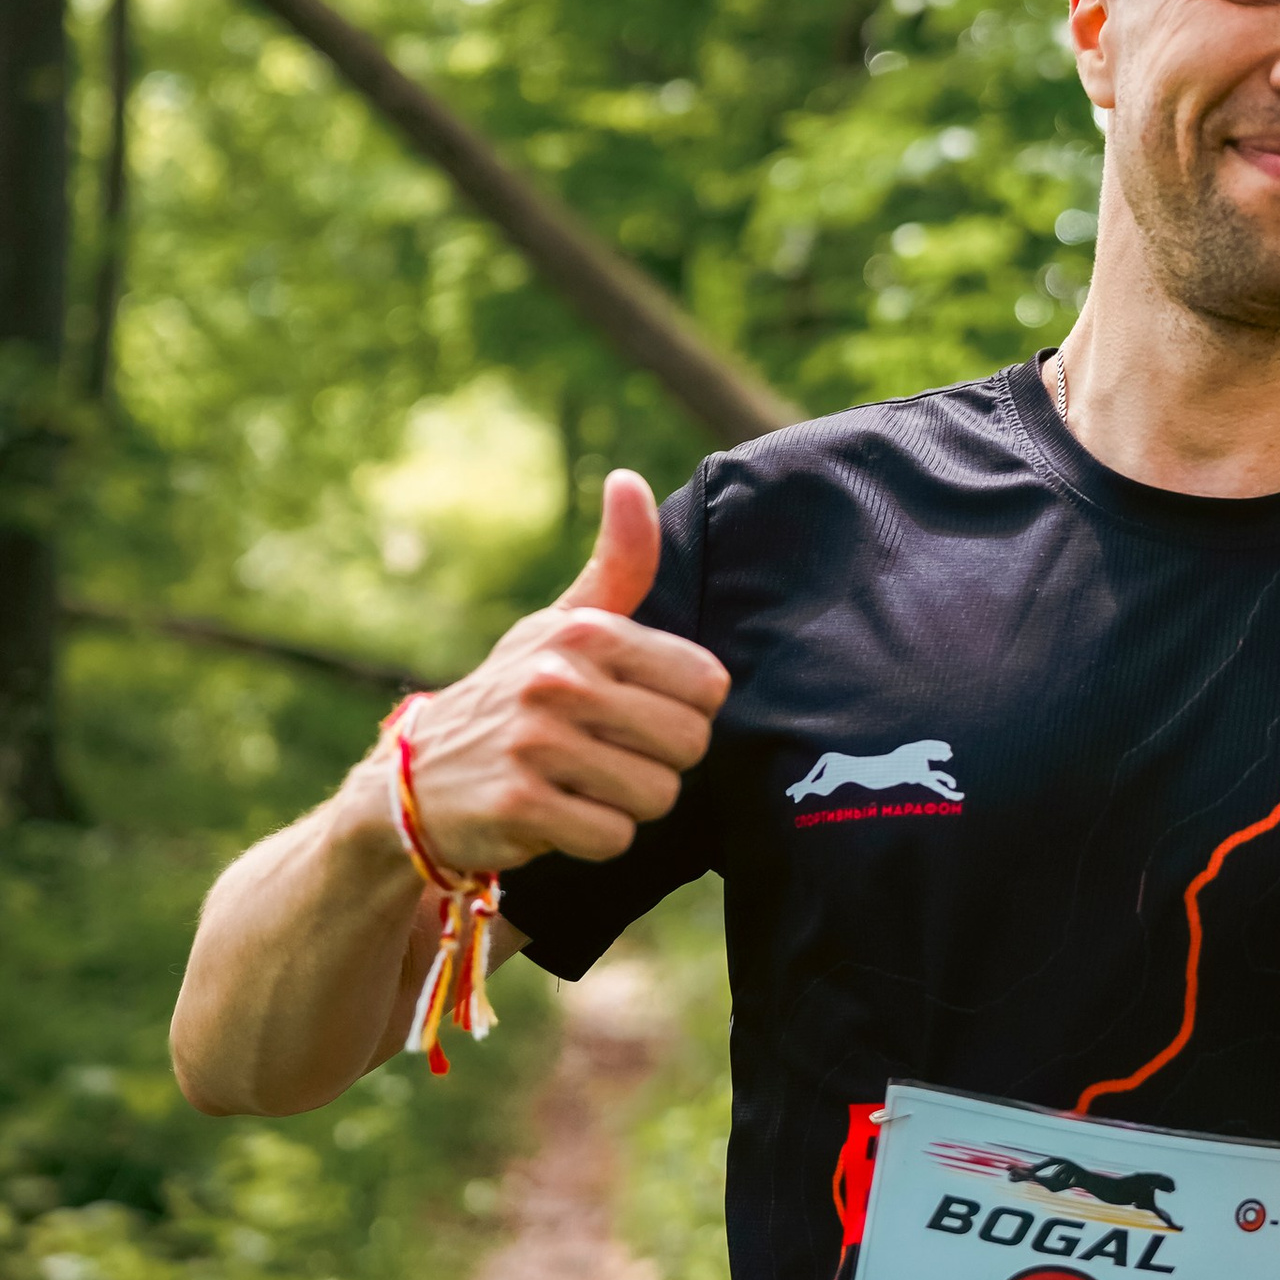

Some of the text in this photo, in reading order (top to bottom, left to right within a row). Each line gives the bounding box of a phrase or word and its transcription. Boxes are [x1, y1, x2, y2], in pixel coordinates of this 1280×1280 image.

[794, 801, 963, 828] СПОРТИВНЫЙ МАРАФОН
[926, 1193, 1176, 1274] BOGAL
